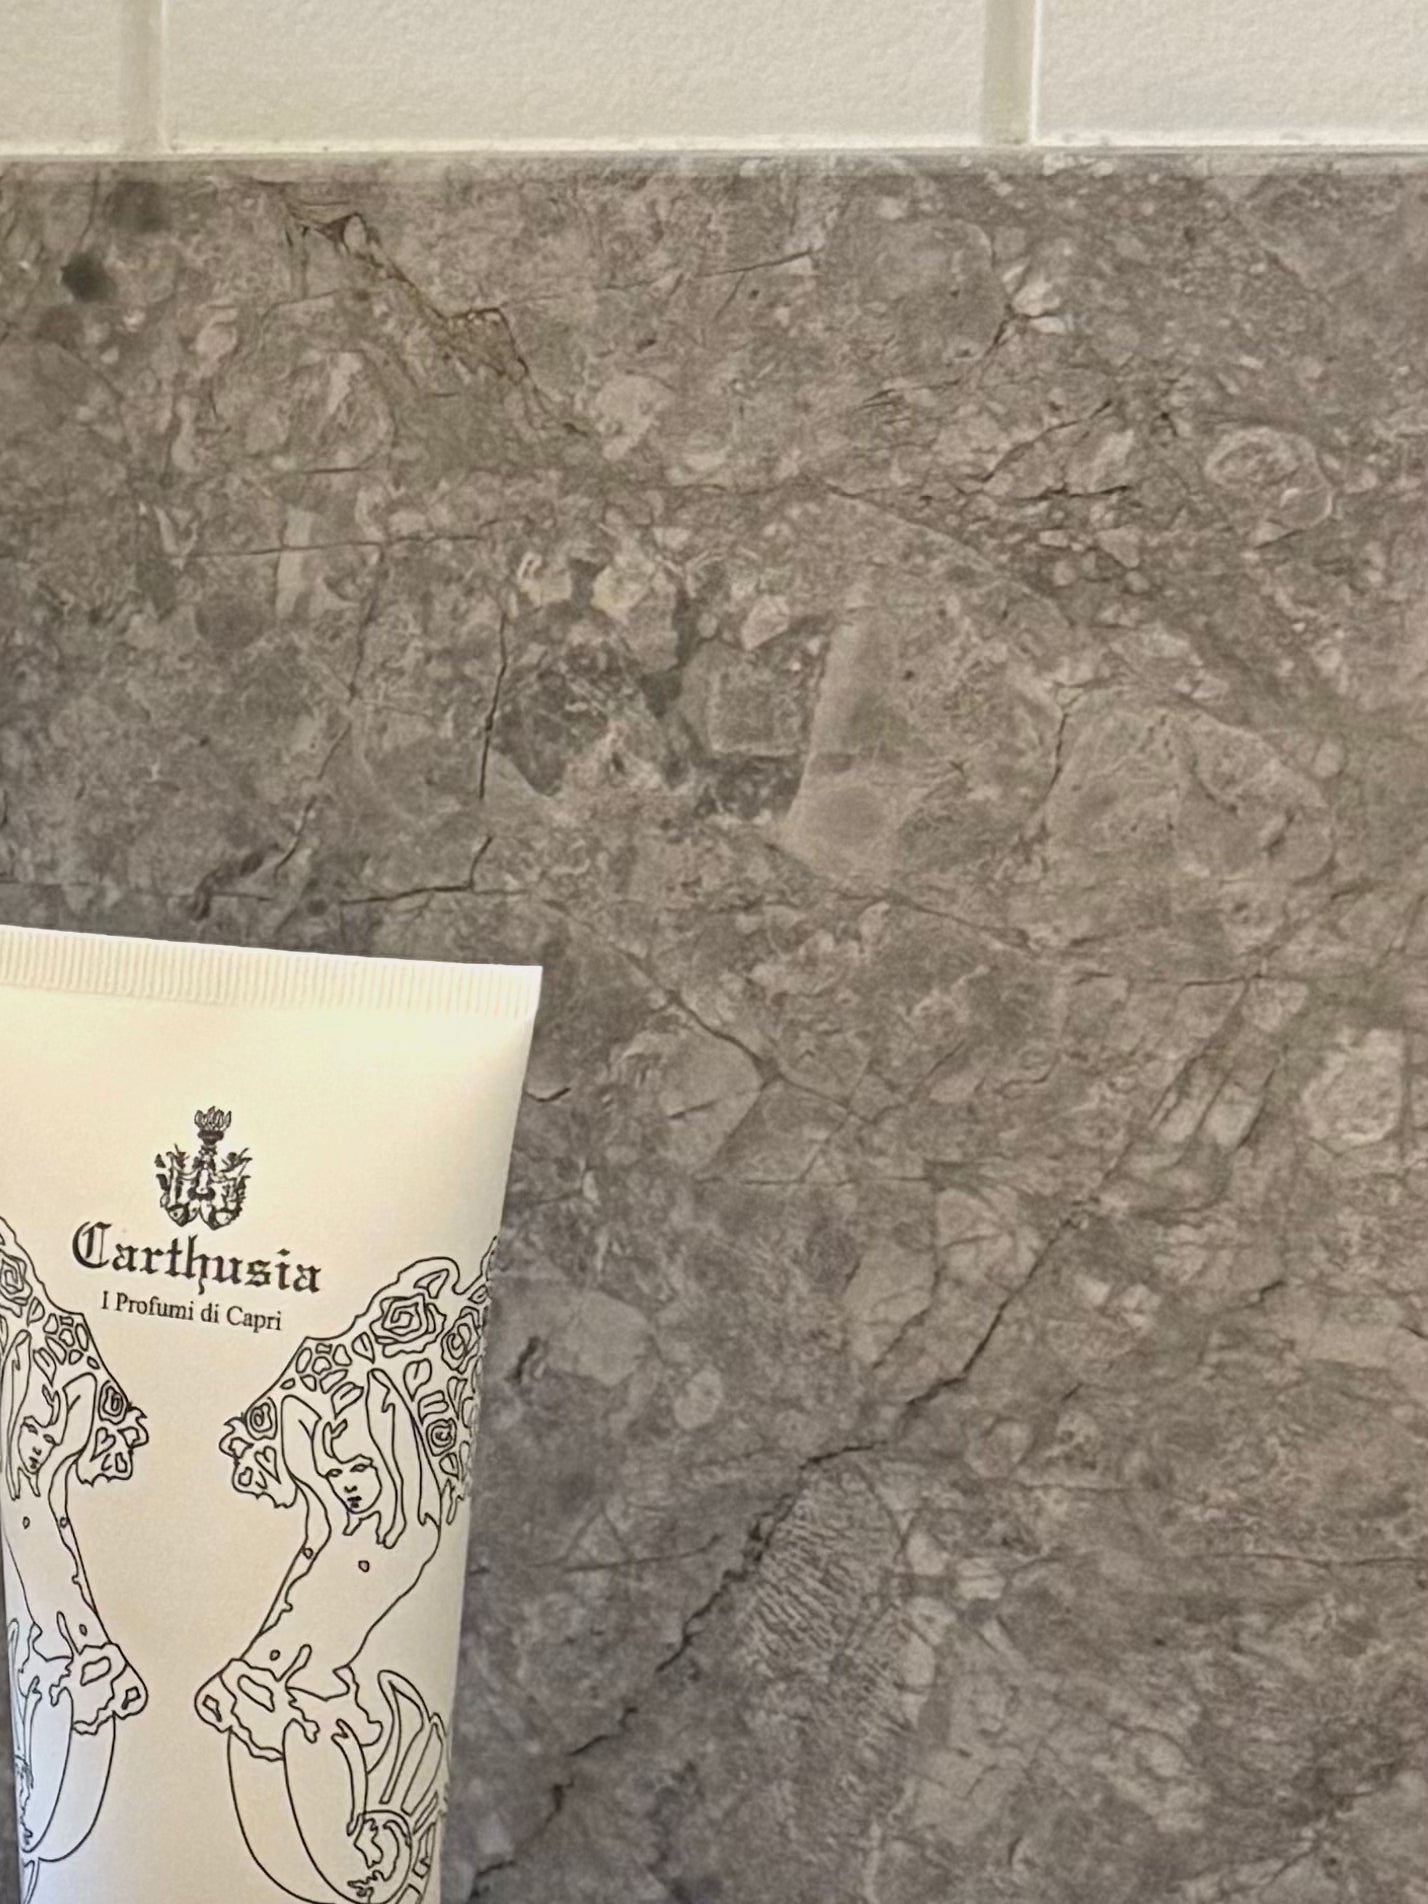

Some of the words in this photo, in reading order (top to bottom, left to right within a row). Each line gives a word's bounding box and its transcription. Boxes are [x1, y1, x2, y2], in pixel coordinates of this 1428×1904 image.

[71, 1220, 321, 1294] Carthusia
[101, 1291, 111, 1311] I
[115, 1293, 194, 1322] Profumi
[200, 1302, 221, 1325] di
[226, 1305, 282, 1332] Capri
